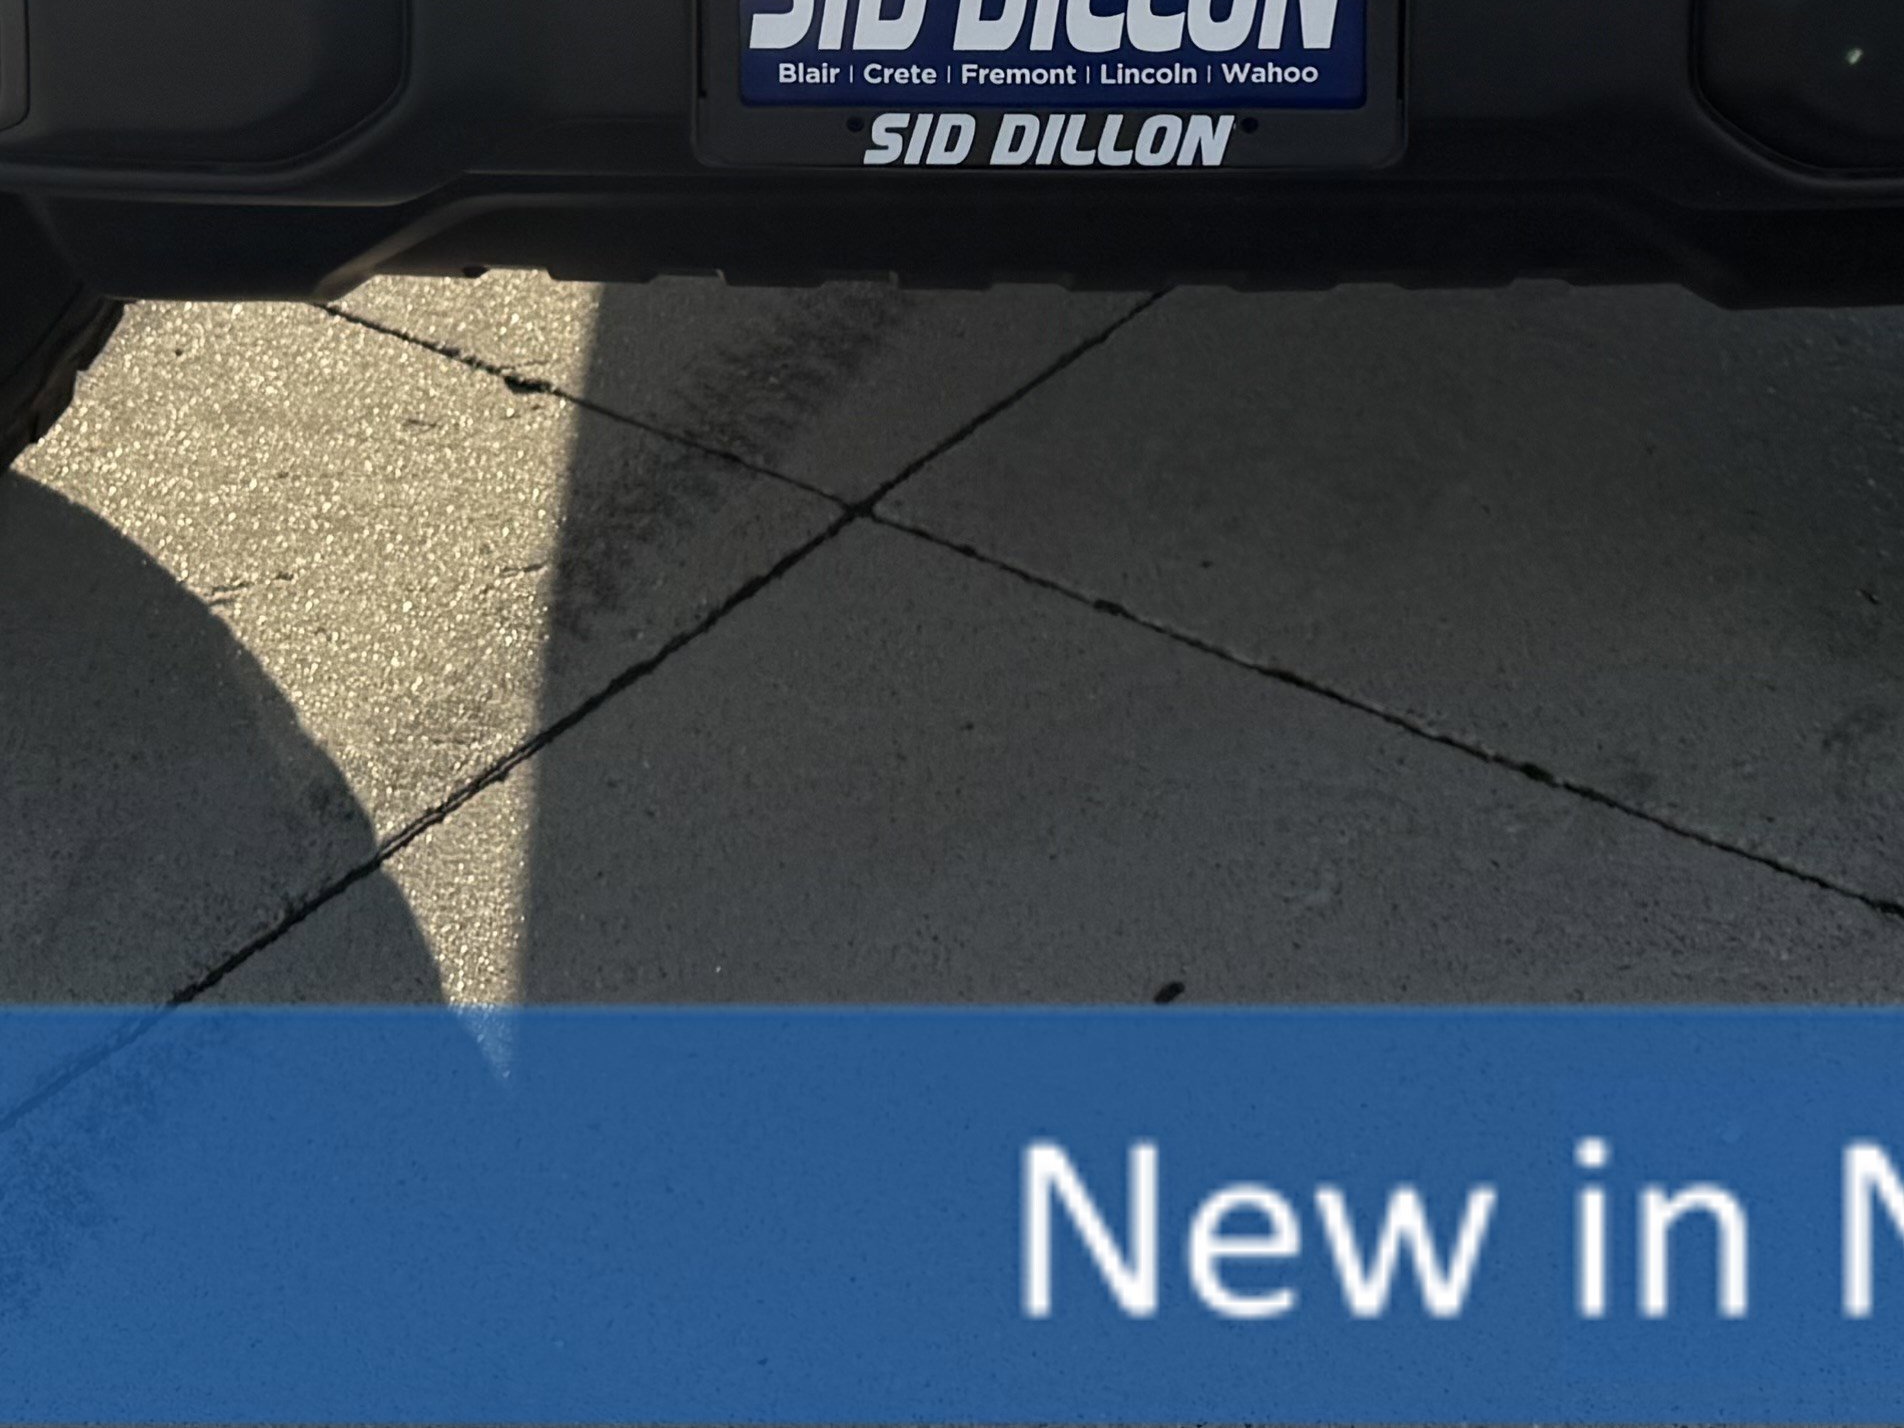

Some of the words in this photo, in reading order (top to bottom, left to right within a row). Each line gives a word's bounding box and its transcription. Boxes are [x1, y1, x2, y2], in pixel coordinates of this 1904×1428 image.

[779, 62, 842, 86] Blair
[863, 63, 939, 86] Crete
[961, 63, 1078, 87] Fremont
[1100, 62, 1199, 86] Lincoln
[1221, 62, 1321, 85] Wahoo
[863, 113, 977, 167] SID
[989, 113, 1237, 168] DILLON
